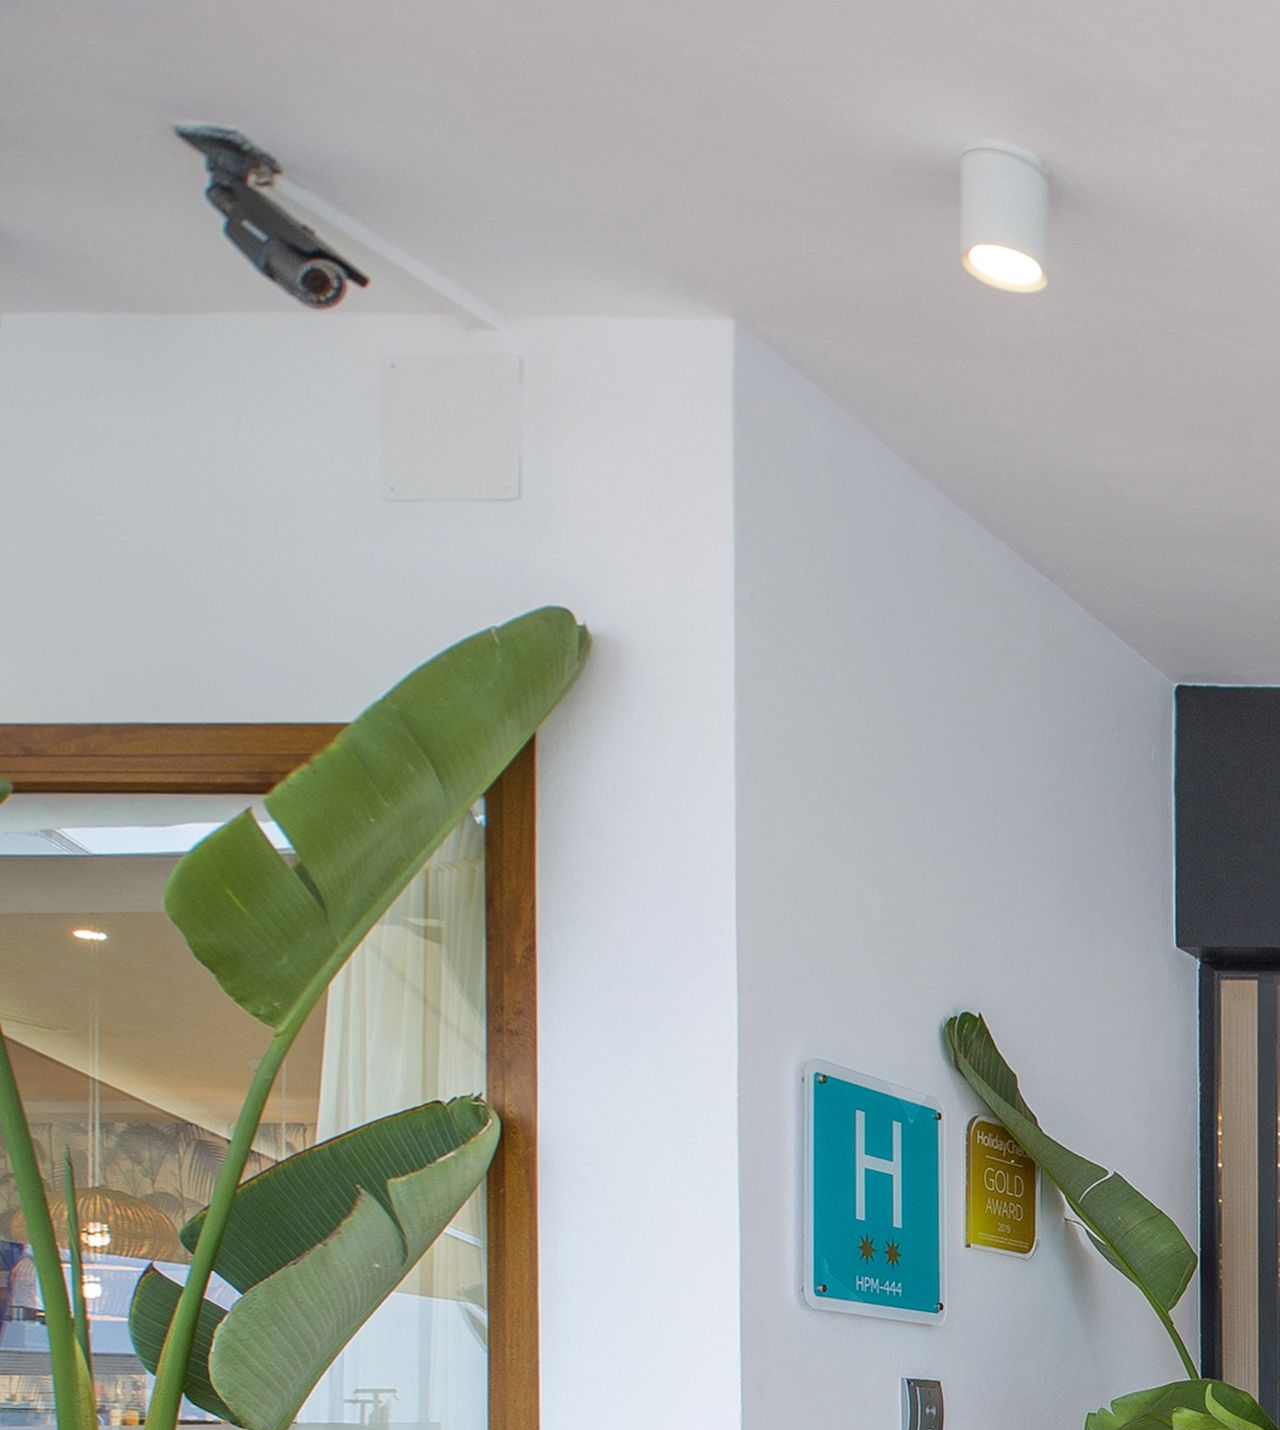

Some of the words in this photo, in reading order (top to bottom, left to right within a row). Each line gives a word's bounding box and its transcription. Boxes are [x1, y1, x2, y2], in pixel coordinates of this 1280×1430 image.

[855, 1109, 902, 1229] H
[983, 1167, 1024, 1197] GOLD
[985, 1197, 1024, 1221] AWARD
[855, 1275, 902, 1298] HPM-444
